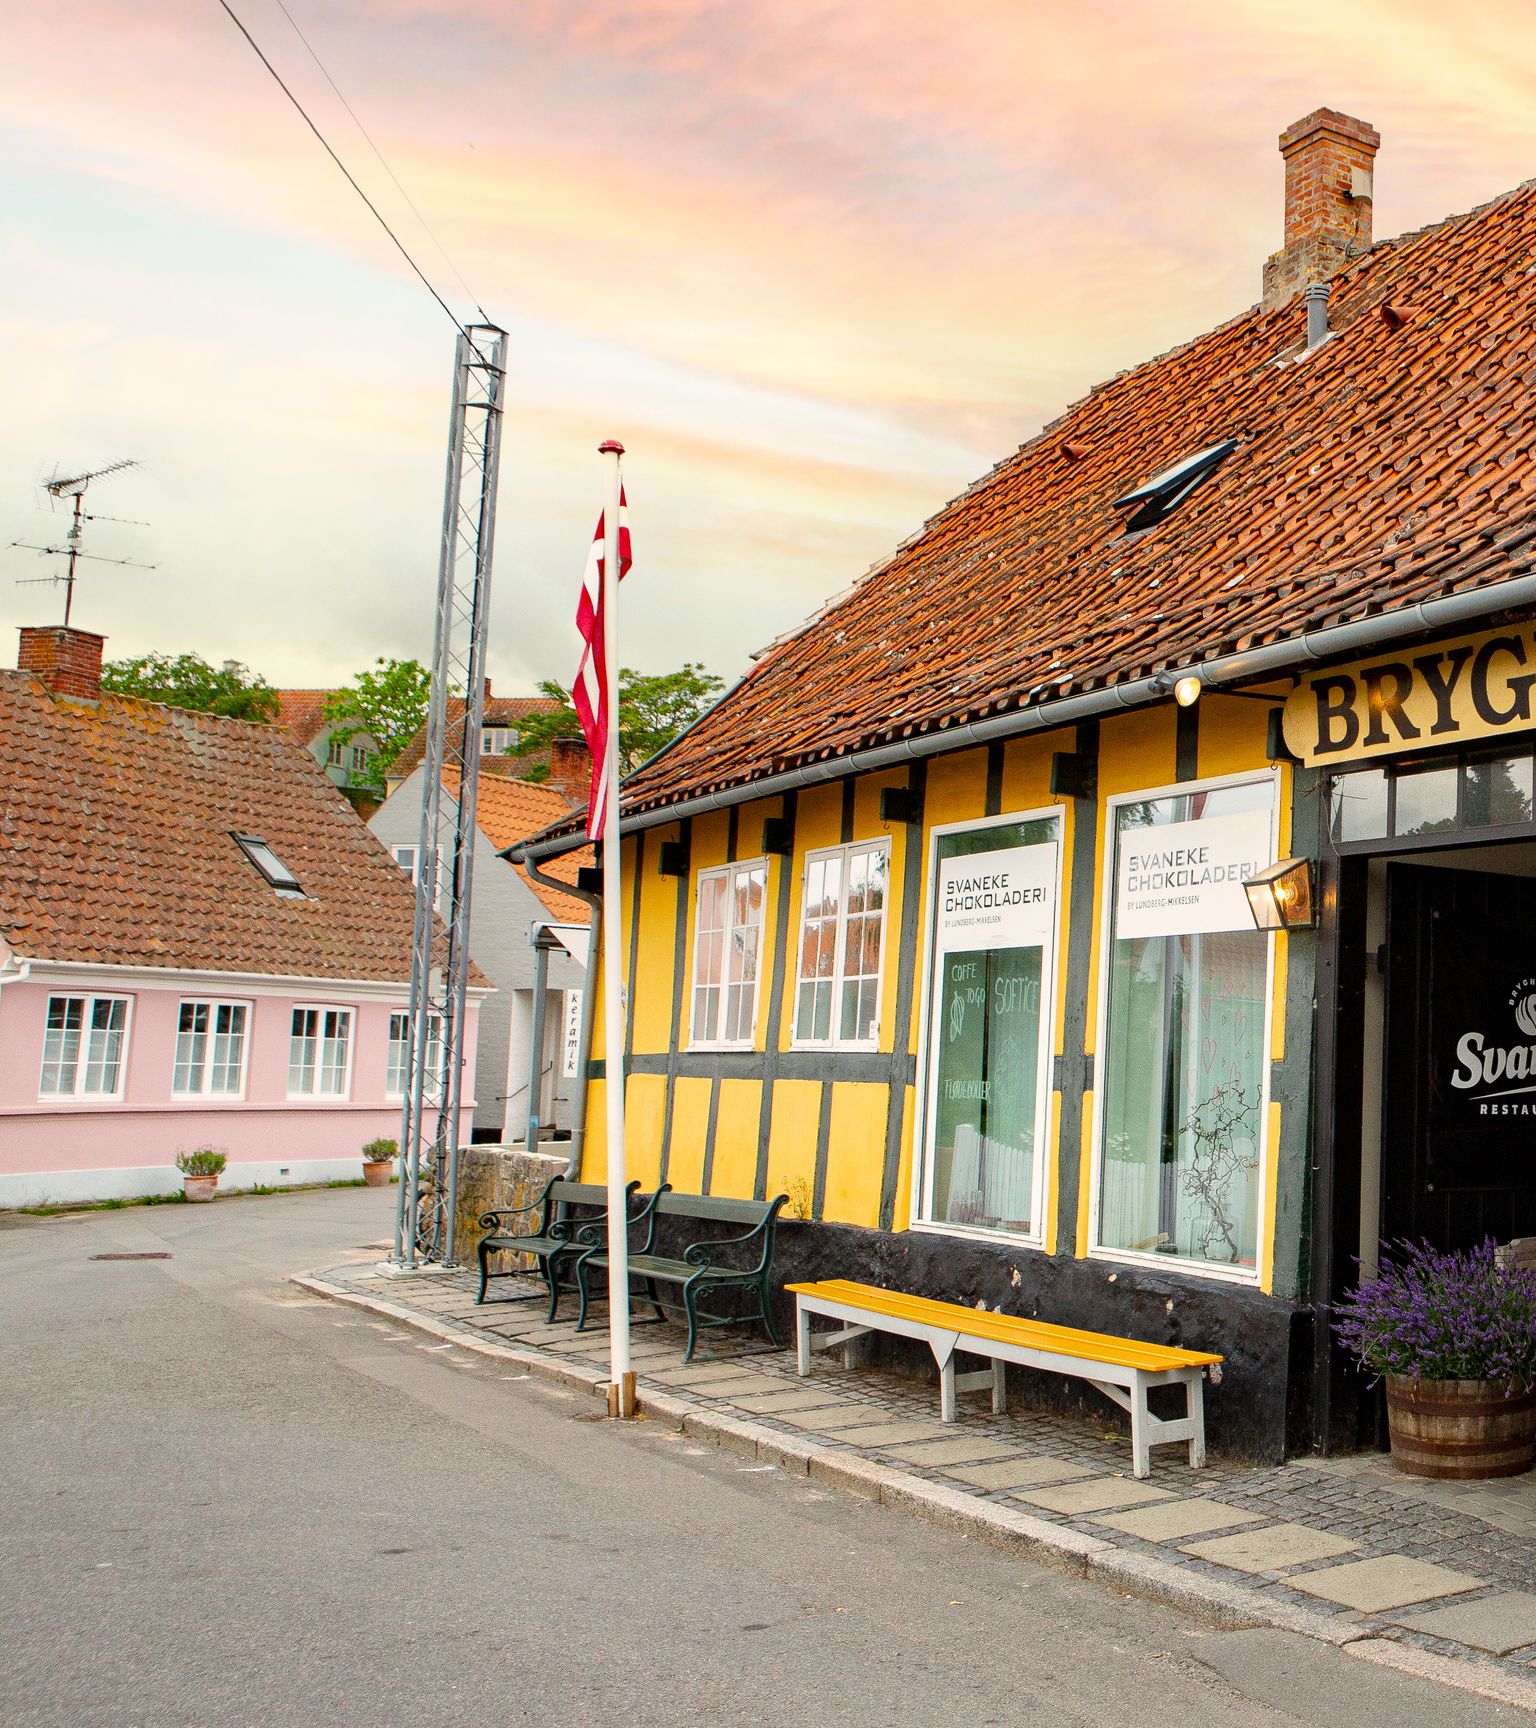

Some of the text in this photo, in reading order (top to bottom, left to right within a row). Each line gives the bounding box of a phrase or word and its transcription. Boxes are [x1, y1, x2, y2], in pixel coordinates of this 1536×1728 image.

[1129, 846, 1210, 872] SVANEKE
[946, 873, 1009, 895] SVANEKE
[1128, 861, 1258, 892] CHOKOLADERI
[945, 887, 1047, 912] CHOKOLADERI
[1127, 895, 1200, 910] BY LUNDBERG-MIKKELSEN
[951, 915, 1002, 927] LUNDBERG-MIKKELSEN
[952, 963, 977, 982] COFFE
[965, 987, 986, 1008] TO GO
[567, 993, 578, 1070] keramik
